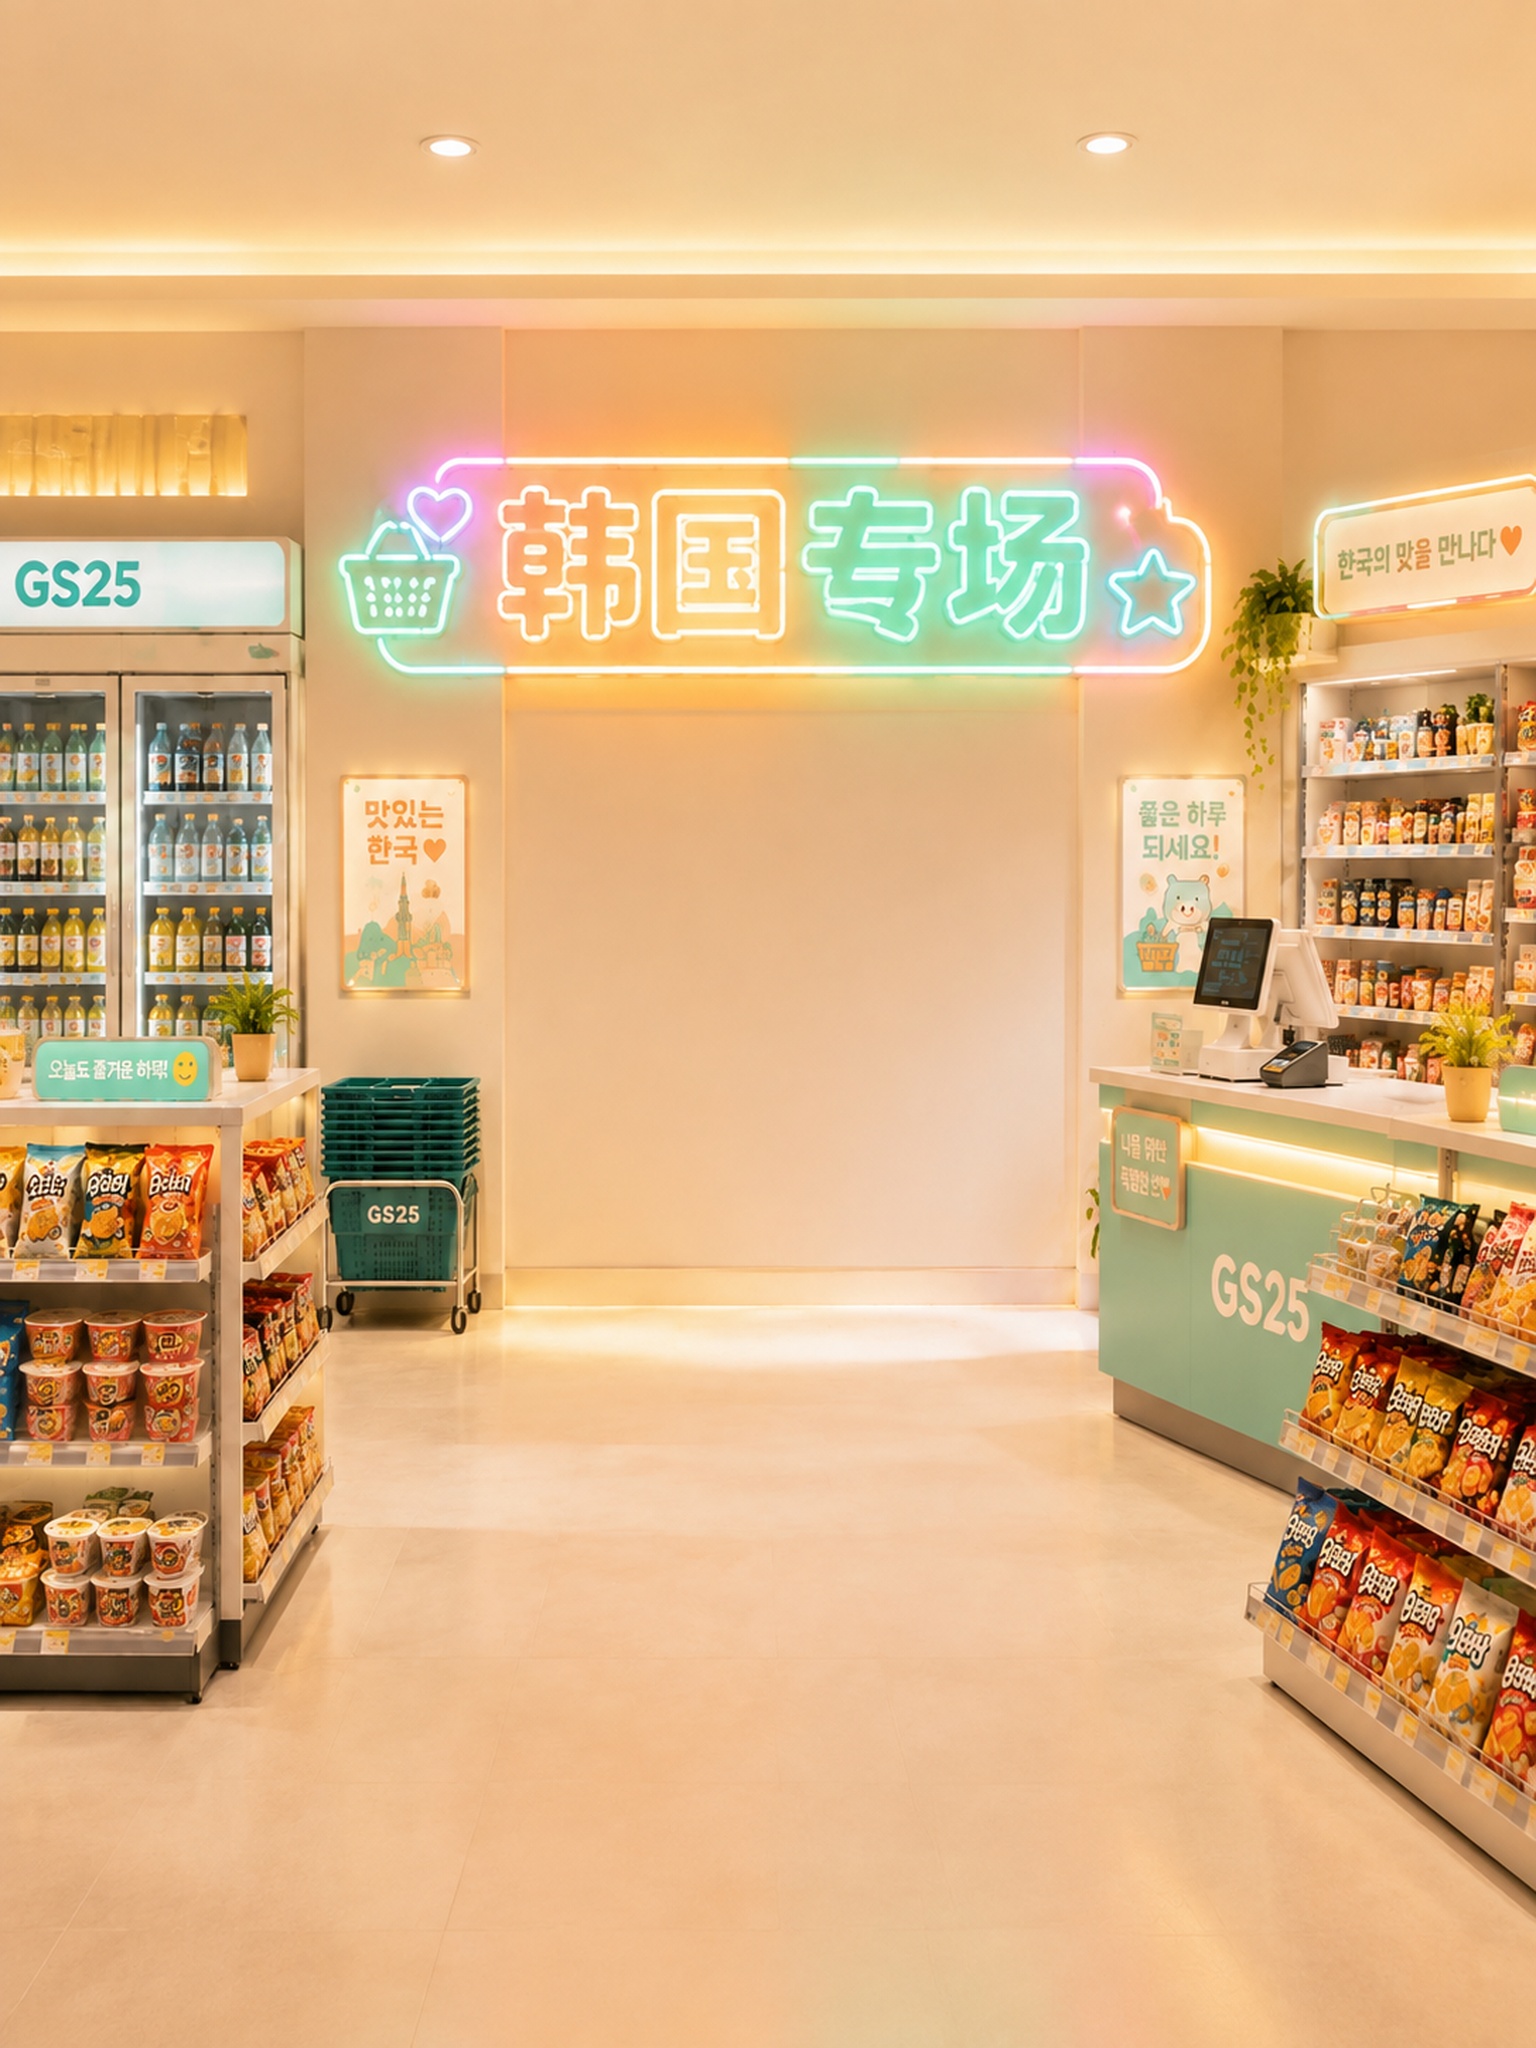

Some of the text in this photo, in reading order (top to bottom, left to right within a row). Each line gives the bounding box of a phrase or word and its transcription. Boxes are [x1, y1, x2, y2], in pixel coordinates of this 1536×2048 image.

[497, 485, 1091, 643] 韩国专场
[1338, 528, 1497, 581] 한국의 맛을 만나다
[15, 560, 142, 608] GS25
[365, 799, 445, 830] 맛있는
[1187, 800, 1227, 828] 하루
[367, 835, 418, 866] 한국
[1142, 833, 1220, 862] 되세요!
[367, 1205, 420, 1224] GS25
[1211, 1253, 1310, 1343] GS25
